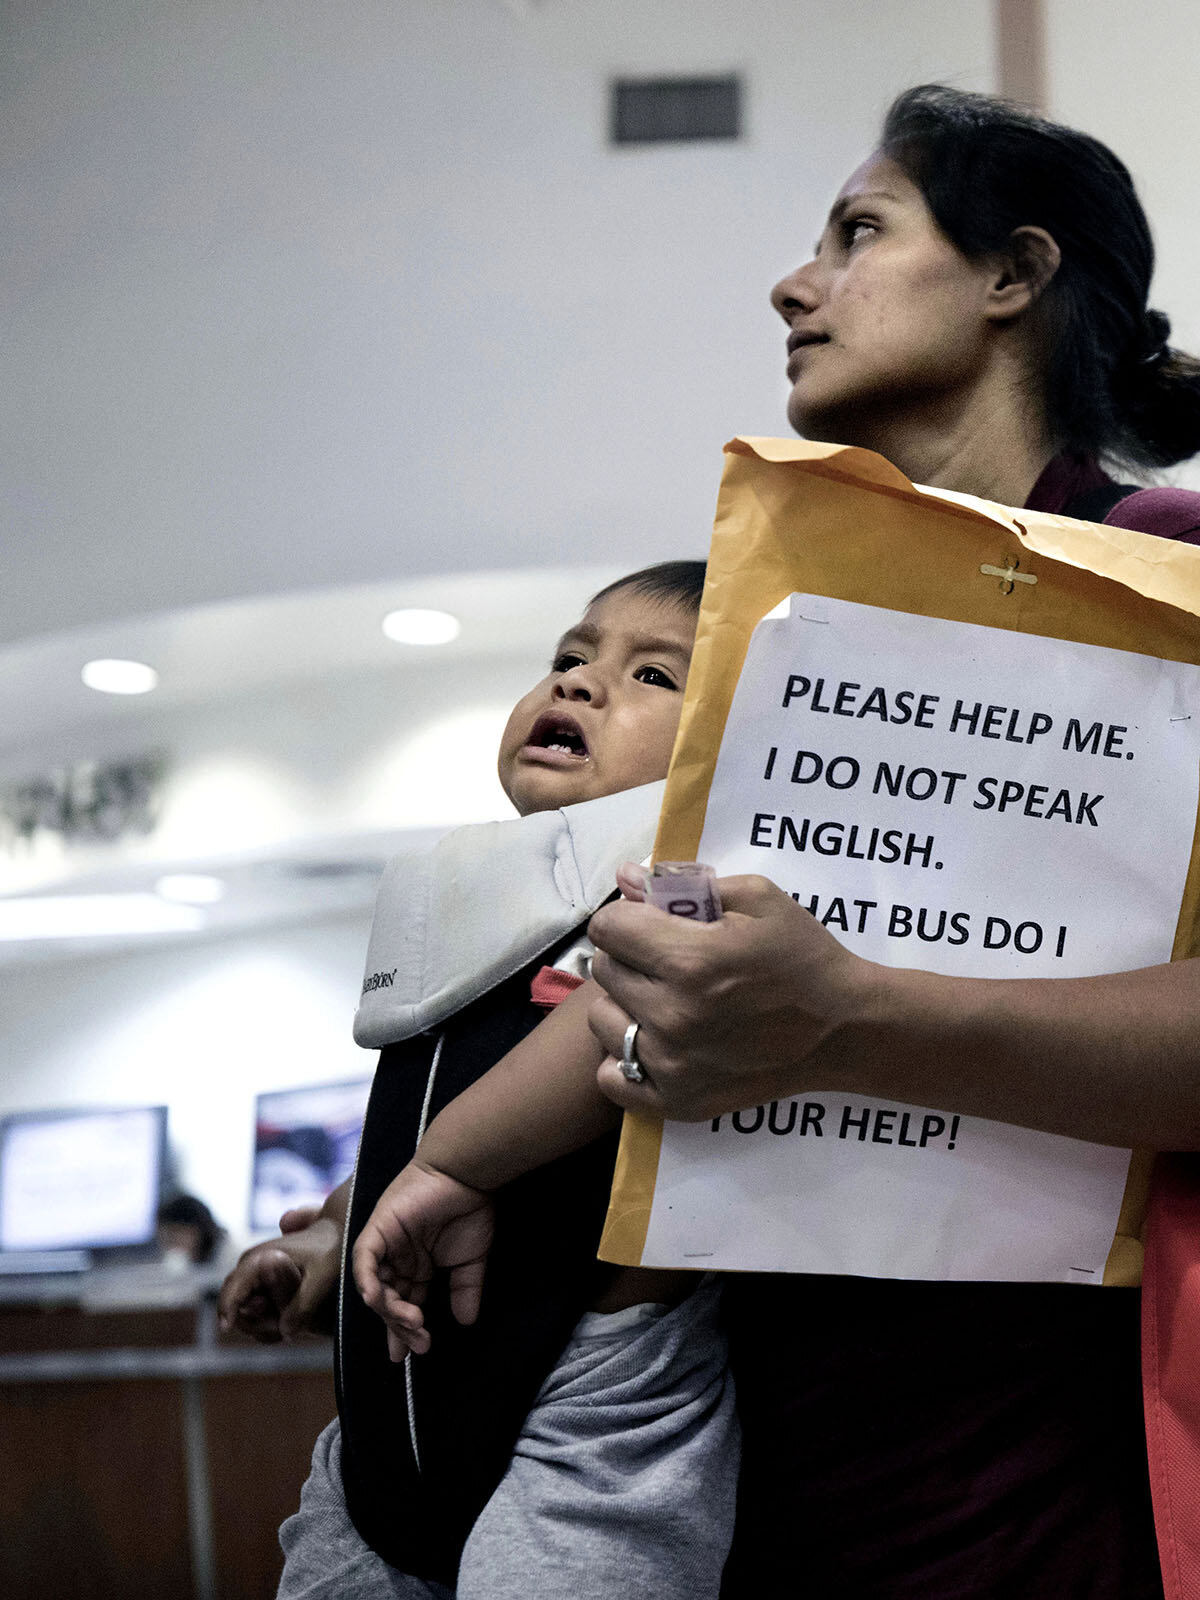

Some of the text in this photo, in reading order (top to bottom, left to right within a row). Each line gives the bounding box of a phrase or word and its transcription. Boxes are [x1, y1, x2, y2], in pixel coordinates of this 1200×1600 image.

[782, 674, 1135, 761] PLEASE HELP ME.
[763, 747, 1105, 827] I DO NOT SPEAK
[750, 813, 945, 870] ENGLISH.
[785, 891, 1067, 958] HAT BUS DO I
[838, 1104, 961, 1151] HELP!
